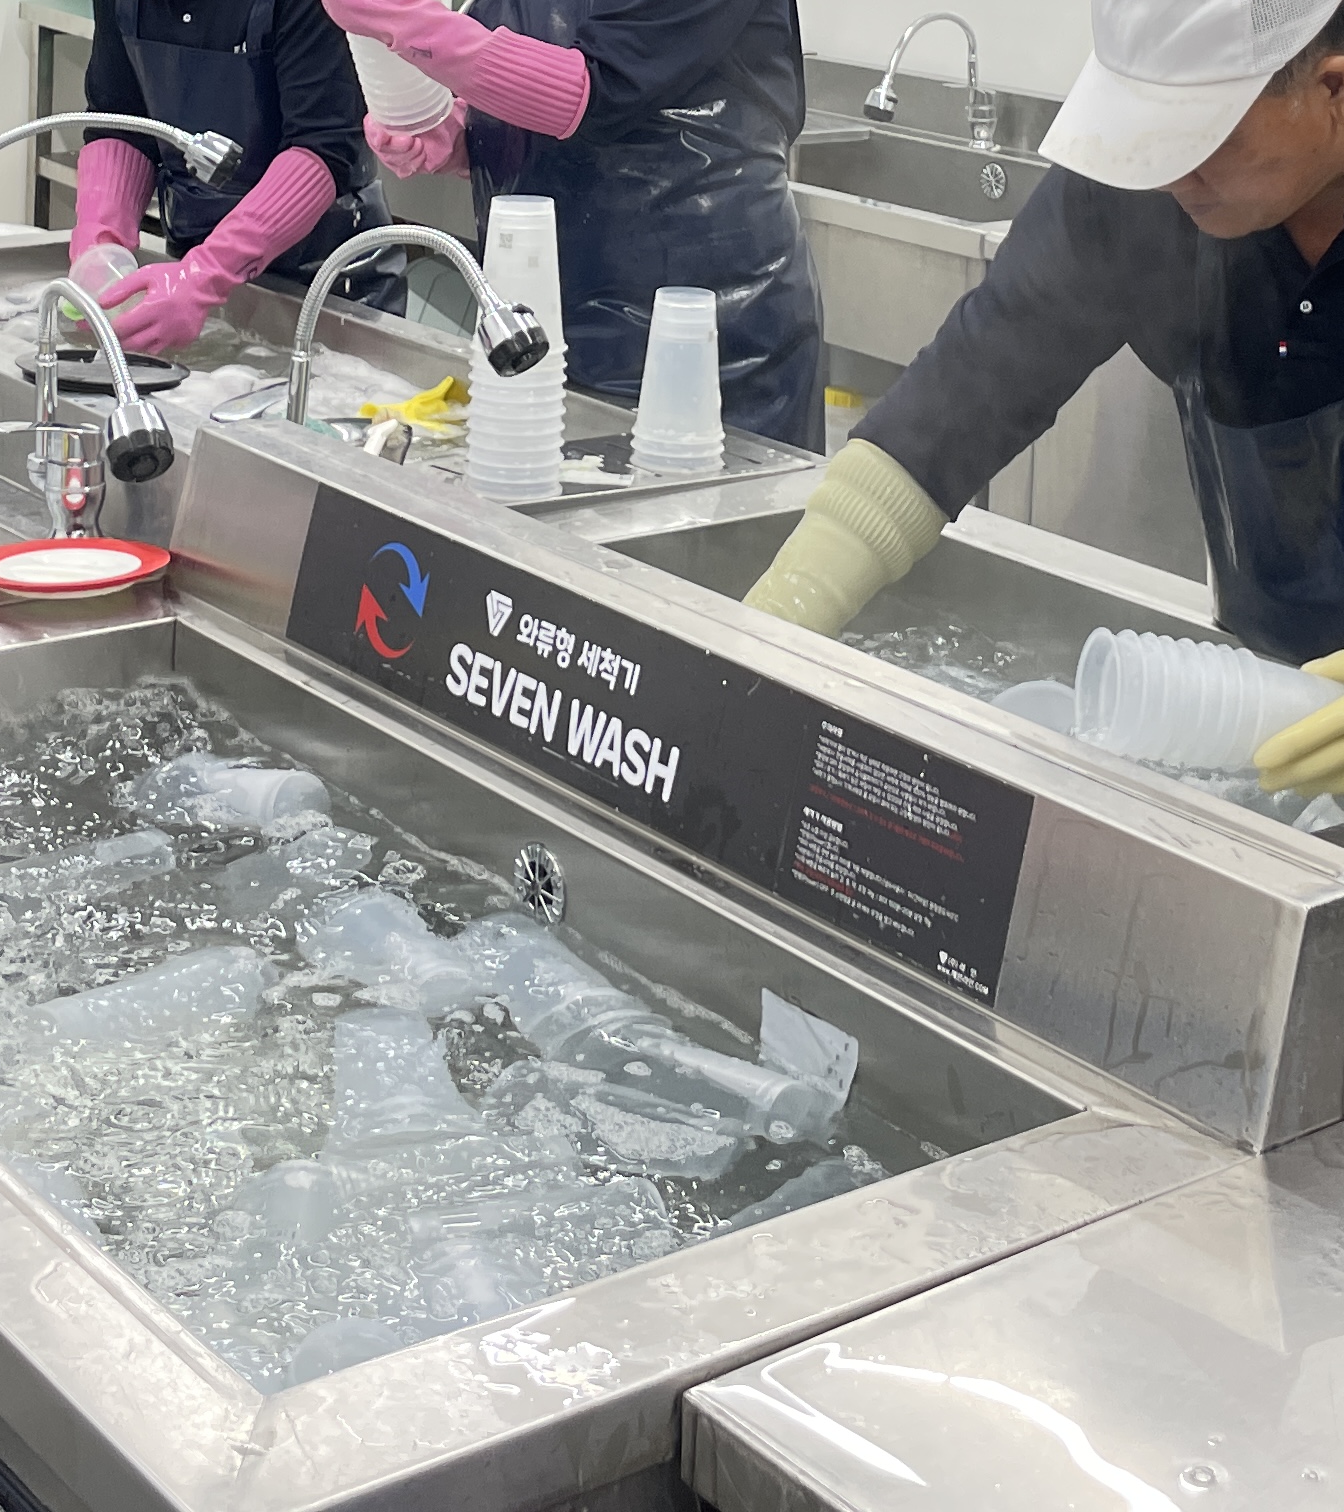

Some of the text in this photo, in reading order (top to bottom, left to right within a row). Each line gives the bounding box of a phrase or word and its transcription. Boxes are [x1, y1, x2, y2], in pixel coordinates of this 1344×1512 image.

[516, 613, 641, 696] 와류형 세척기
[445, 643, 680, 803] SEVEN WASH
